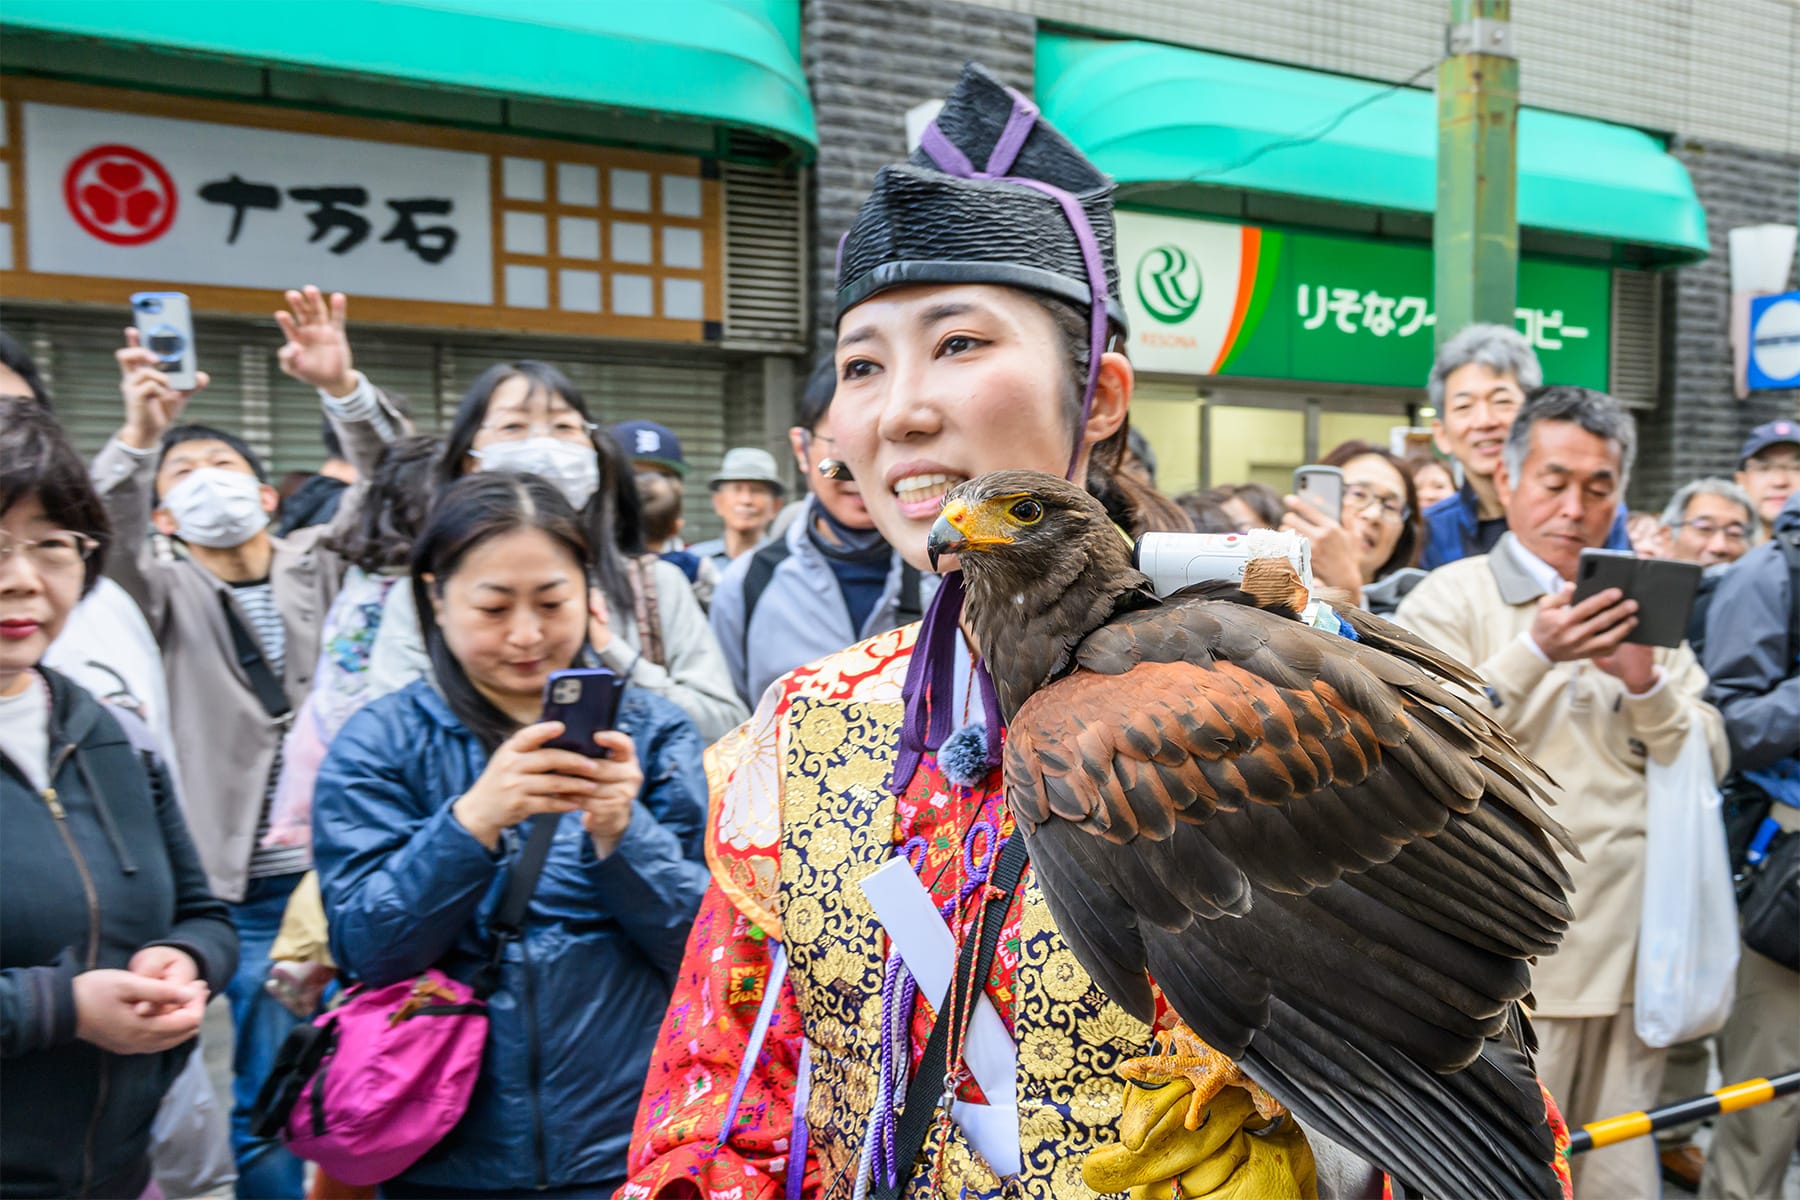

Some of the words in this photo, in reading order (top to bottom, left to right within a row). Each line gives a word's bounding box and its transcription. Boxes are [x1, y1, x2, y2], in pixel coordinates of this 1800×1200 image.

[197, 174, 459, 264] 十万石
[1140, 333, 1198, 348] RESONA
